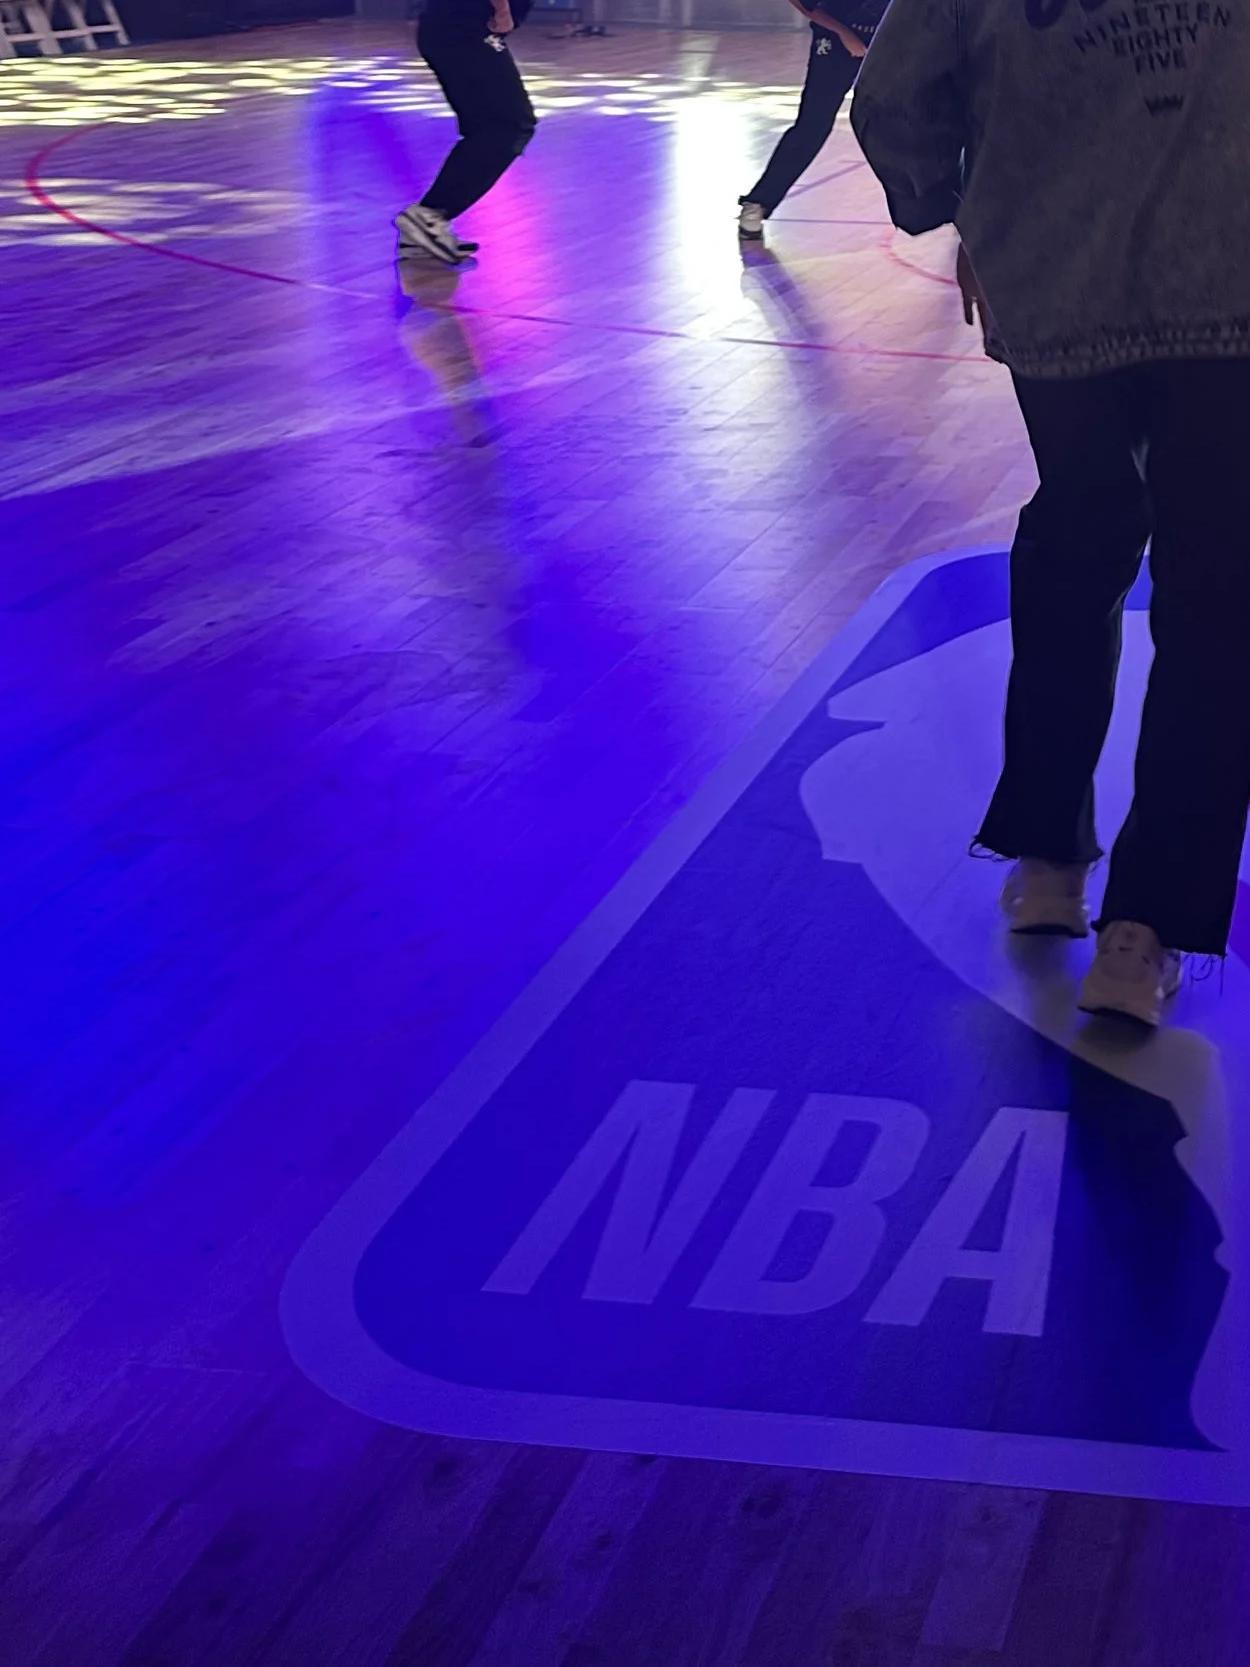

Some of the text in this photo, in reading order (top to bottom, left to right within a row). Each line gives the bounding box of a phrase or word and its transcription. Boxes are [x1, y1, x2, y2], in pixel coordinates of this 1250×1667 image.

[1073, 2, 1232, 54] NINETEEN
[1112, 23, 1198, 56] EIGHTY
[1134, 49, 1187, 74] FIVE
[479, 1079, 1070, 1337] NBA
